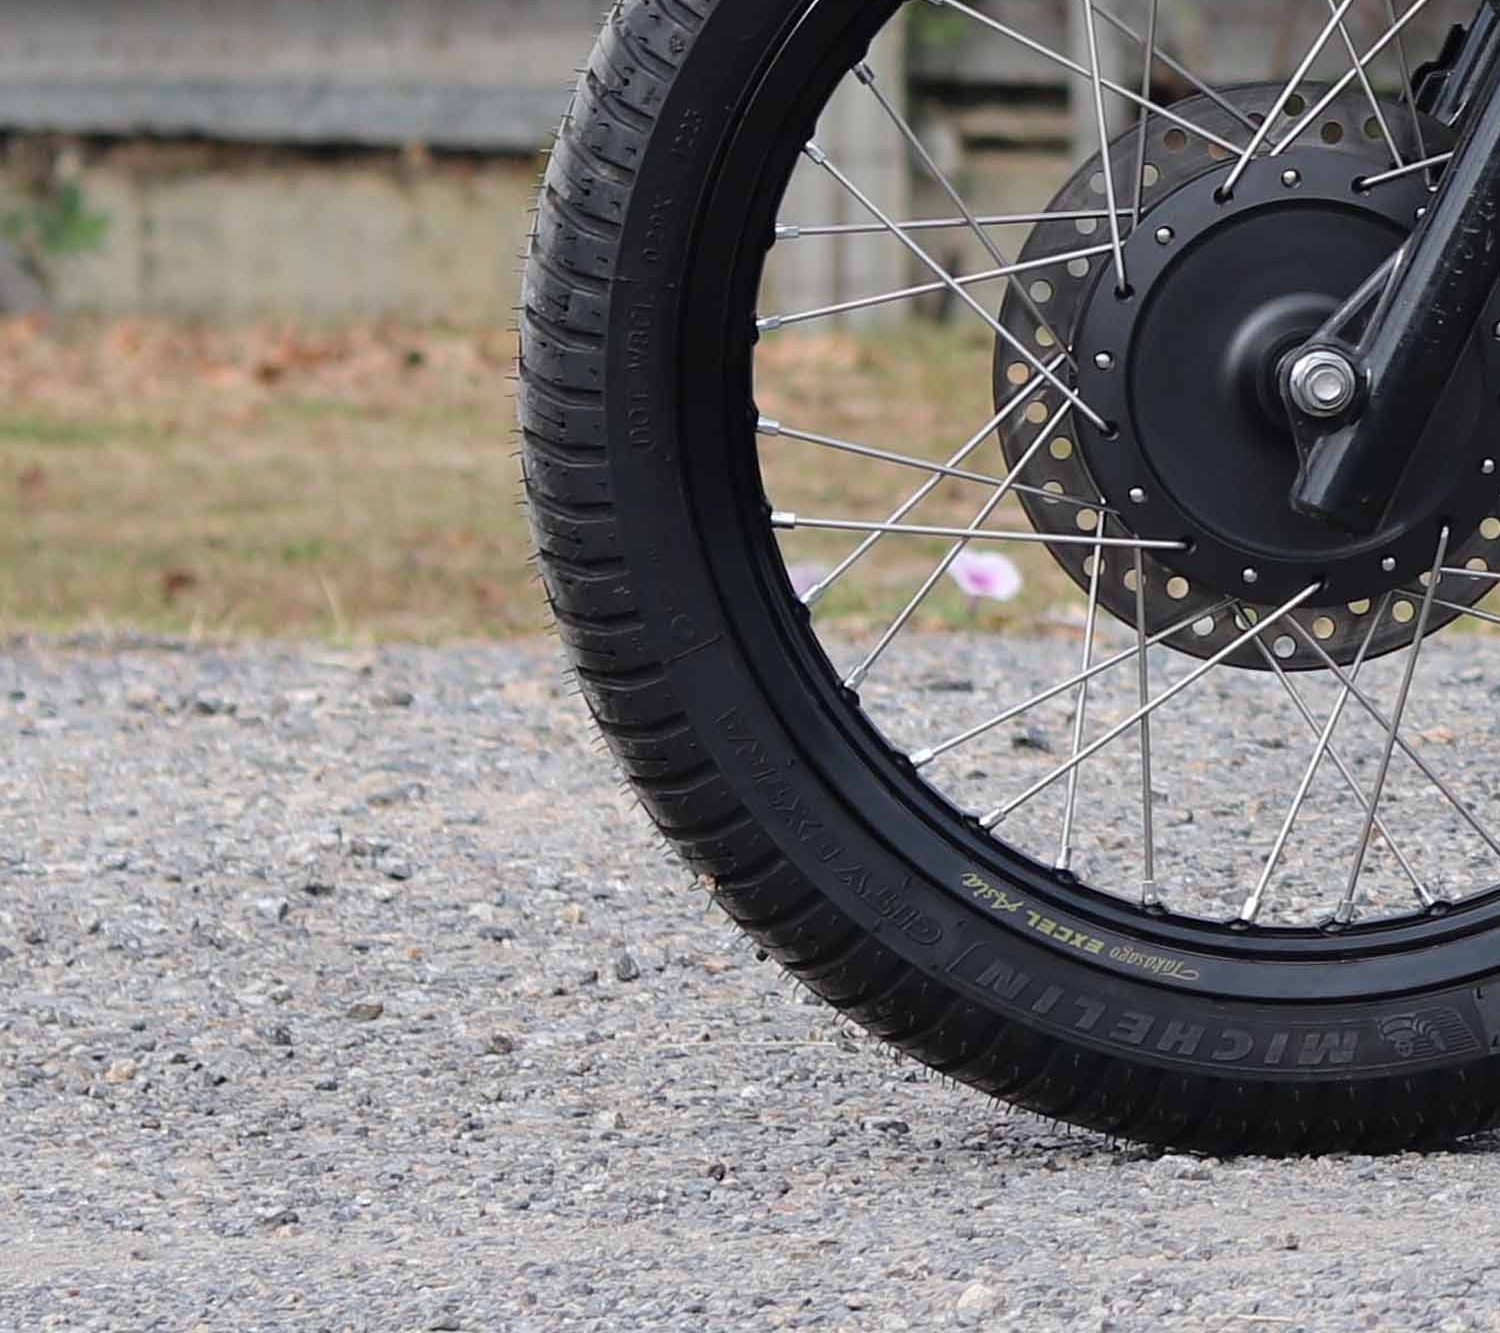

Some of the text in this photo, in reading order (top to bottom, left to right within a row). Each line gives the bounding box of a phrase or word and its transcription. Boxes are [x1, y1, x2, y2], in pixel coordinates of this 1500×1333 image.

[954, 866, 1025, 921] Asia
[1020, 907, 1107, 956] EXCEL
[971, 951, 1364, 1067] MICHELIN
